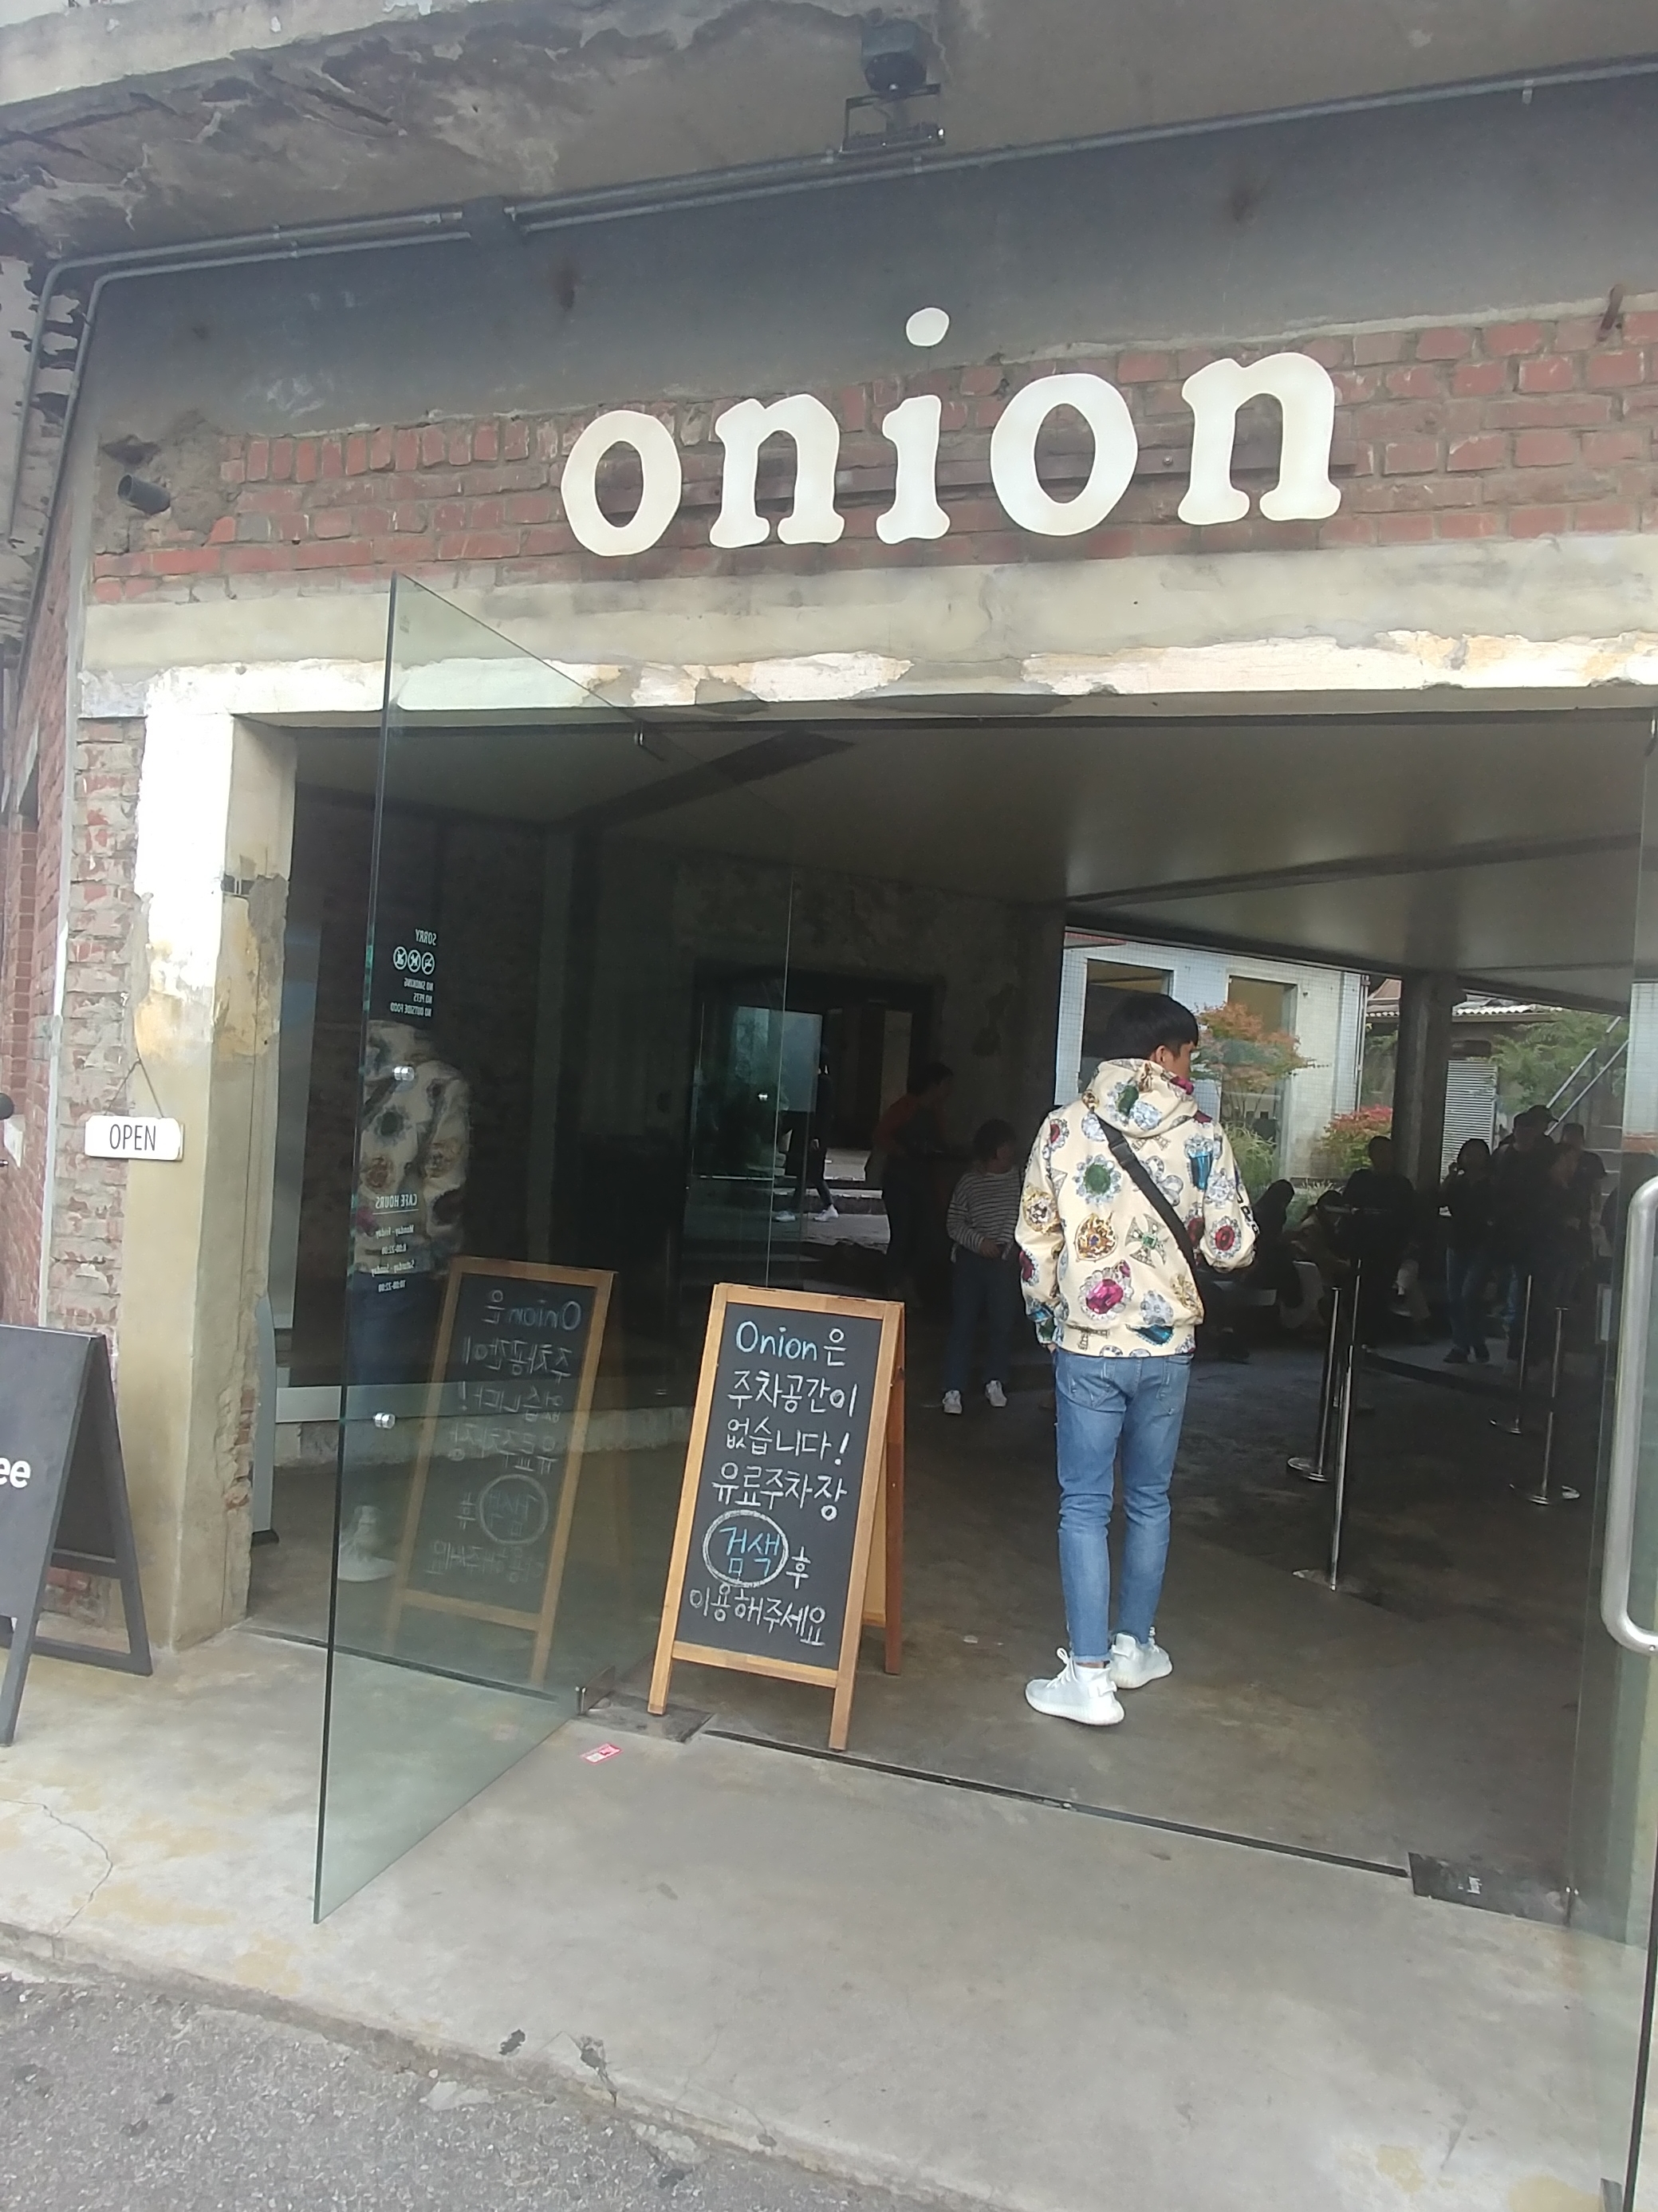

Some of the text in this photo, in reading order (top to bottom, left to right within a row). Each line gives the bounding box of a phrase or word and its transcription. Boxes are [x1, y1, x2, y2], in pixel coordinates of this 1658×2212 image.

[561, 307, 1342, 557] onion
[108, 1123, 156, 1152] OPEN
[727, 1370, 857, 1417] 주차공간이
[726, 1417, 850, 1465] 없습니다!
[719, 1526, 811, 1590] 검색 후
